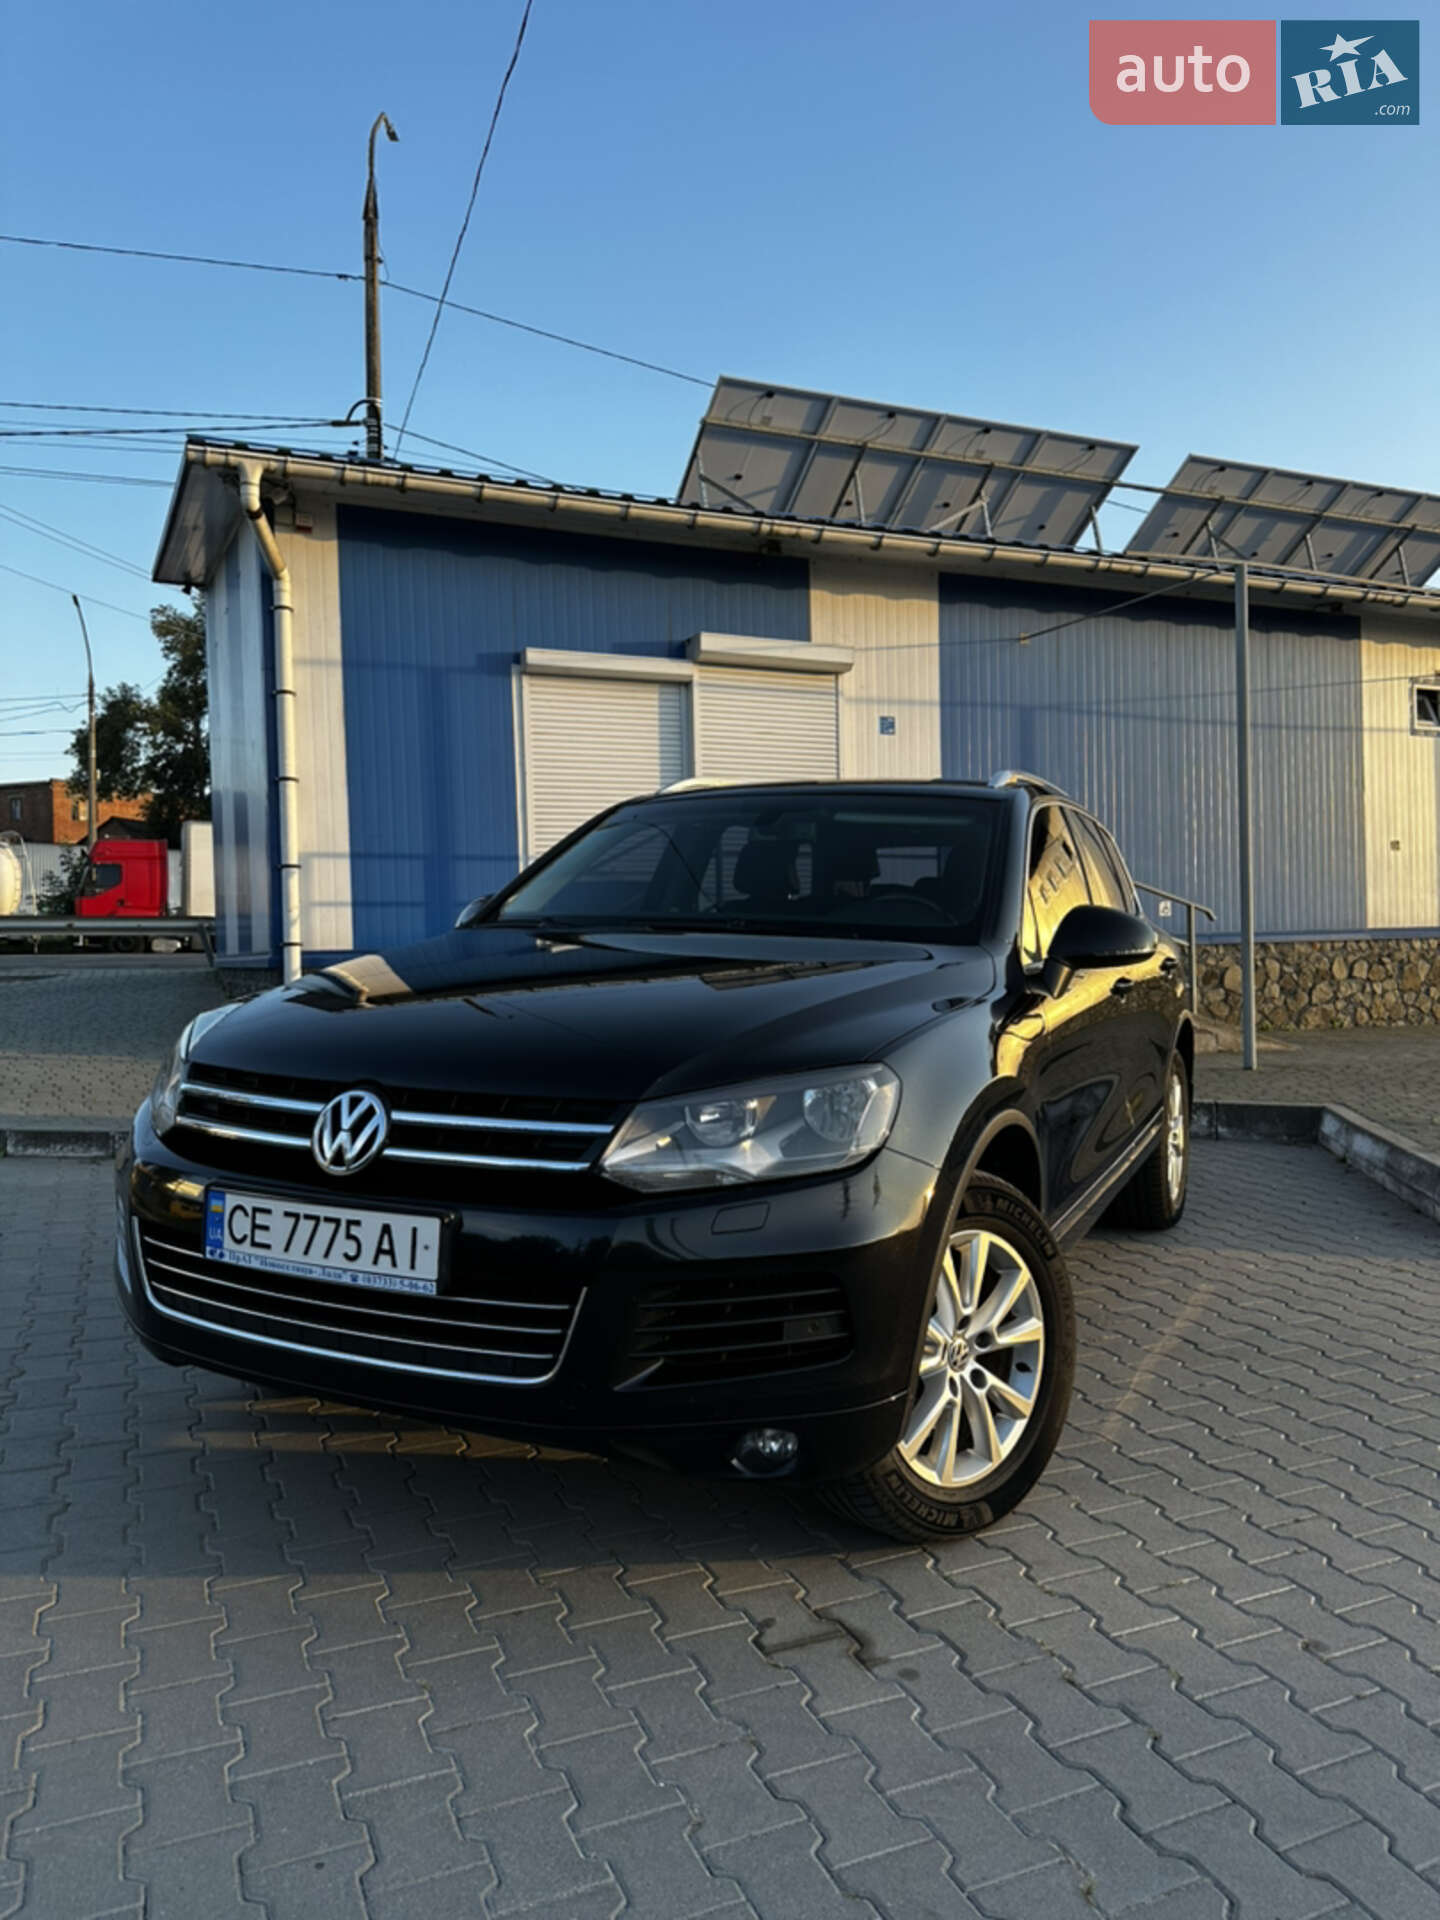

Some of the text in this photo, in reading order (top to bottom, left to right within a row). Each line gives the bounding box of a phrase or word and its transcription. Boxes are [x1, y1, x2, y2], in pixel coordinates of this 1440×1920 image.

[312, 1089, 388, 1176] VW
[228, 1204, 418, 1271] CE 7775 AI
[995, 1197, 1057, 1258] MICHELIN
[886, 1472, 959, 1527] MICHELIN
